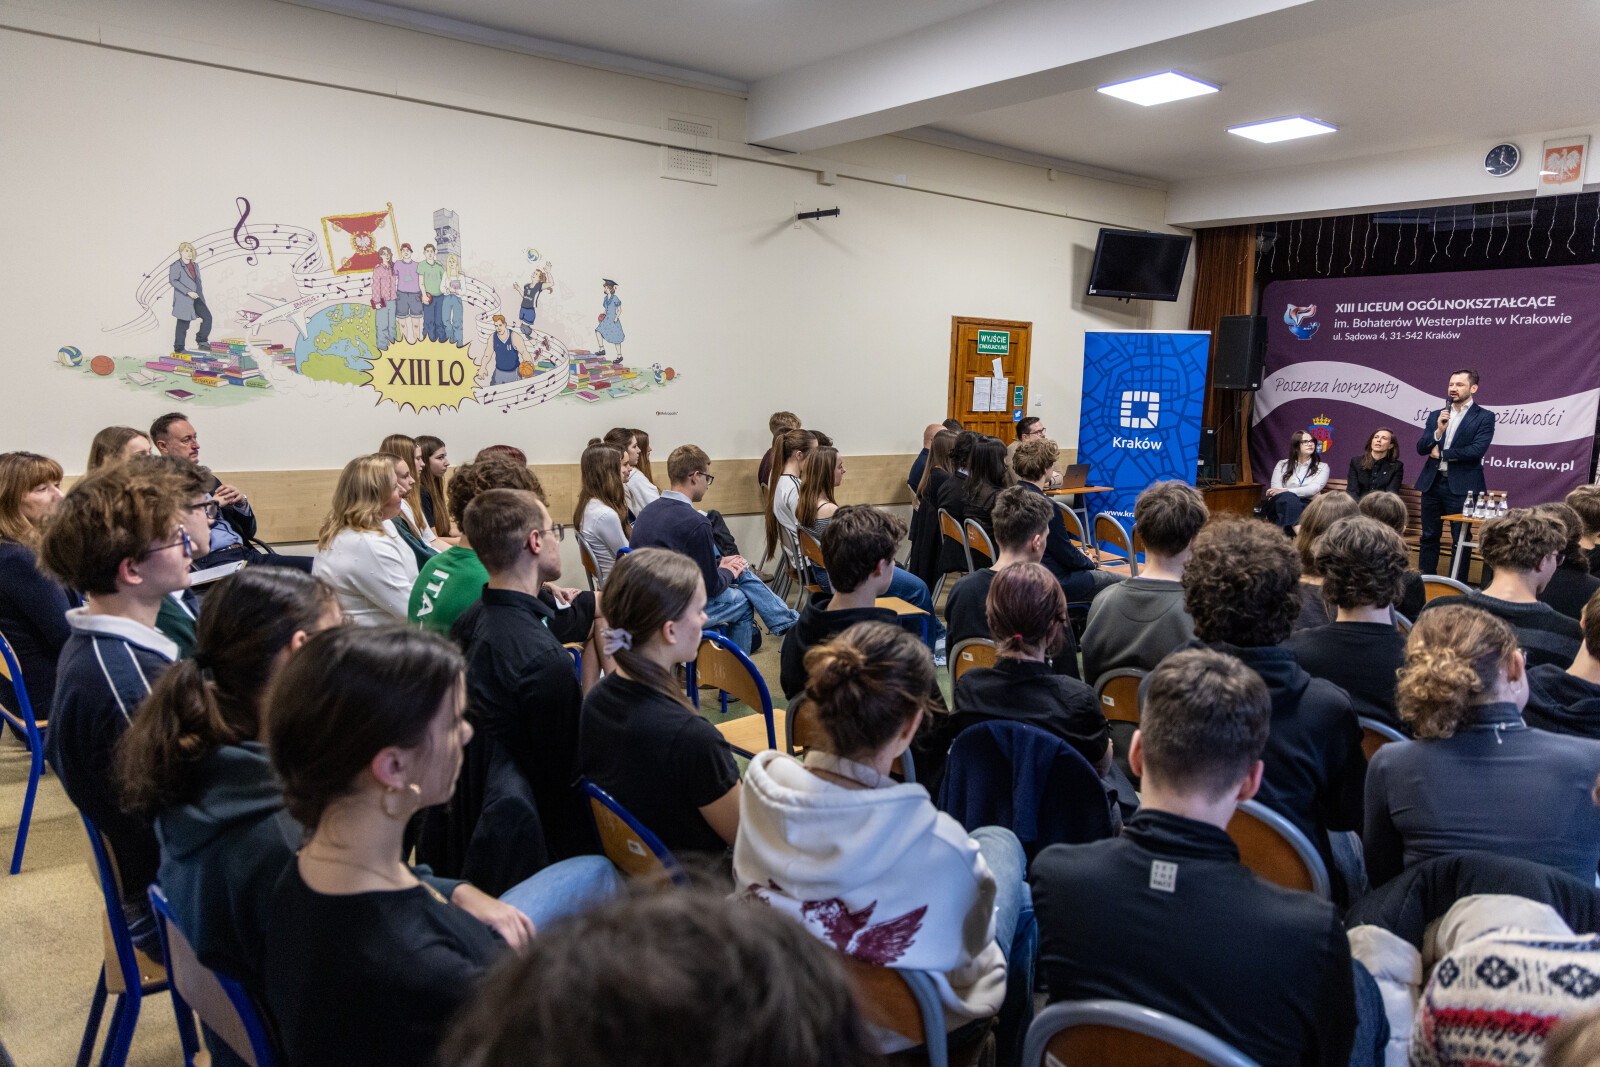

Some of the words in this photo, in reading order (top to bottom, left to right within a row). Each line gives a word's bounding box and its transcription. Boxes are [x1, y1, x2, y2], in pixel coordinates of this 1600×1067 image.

[1335, 303, 1355, 313] XIII
[1357, 301, 1404, 312] LICEUM
[1406, 296, 1556, 311] OGÓLNOKSZTAŁCĄCE
[1334, 319, 1350, 328] im.
[1352, 317, 1412, 328] Bohaterów
[1416, 315, 1492, 328] Westerplatte
[1495, 316, 1506, 324] w
[1510, 312, 1572, 324] Krakowie
[980, 334, 1006, 343] WYJŚCIE
[1332, 332, 1342, 340] ul.
[1344, 333, 1378, 341] Sądowa
[1380, 332, 1388, 340] 4,
[1390, 332, 1422, 340] 31-542
[1425, 331, 1460, 340] Kraków
[387, 358, 431, 385] XIII
[437, 360, 464, 386] LO
[1276, 378, 1328, 393] Poszerza
[1332, 378, 1399, 399] horyzonty
[1414, 407, 1431, 421] st
[1495, 408, 1565, 426] ożliwości
[1112, 436, 1162, 450] Kraków
[1481, 456, 1574, 472] i-lo.krakow.pl
[1104, 510, 1135, 518] www.kra
